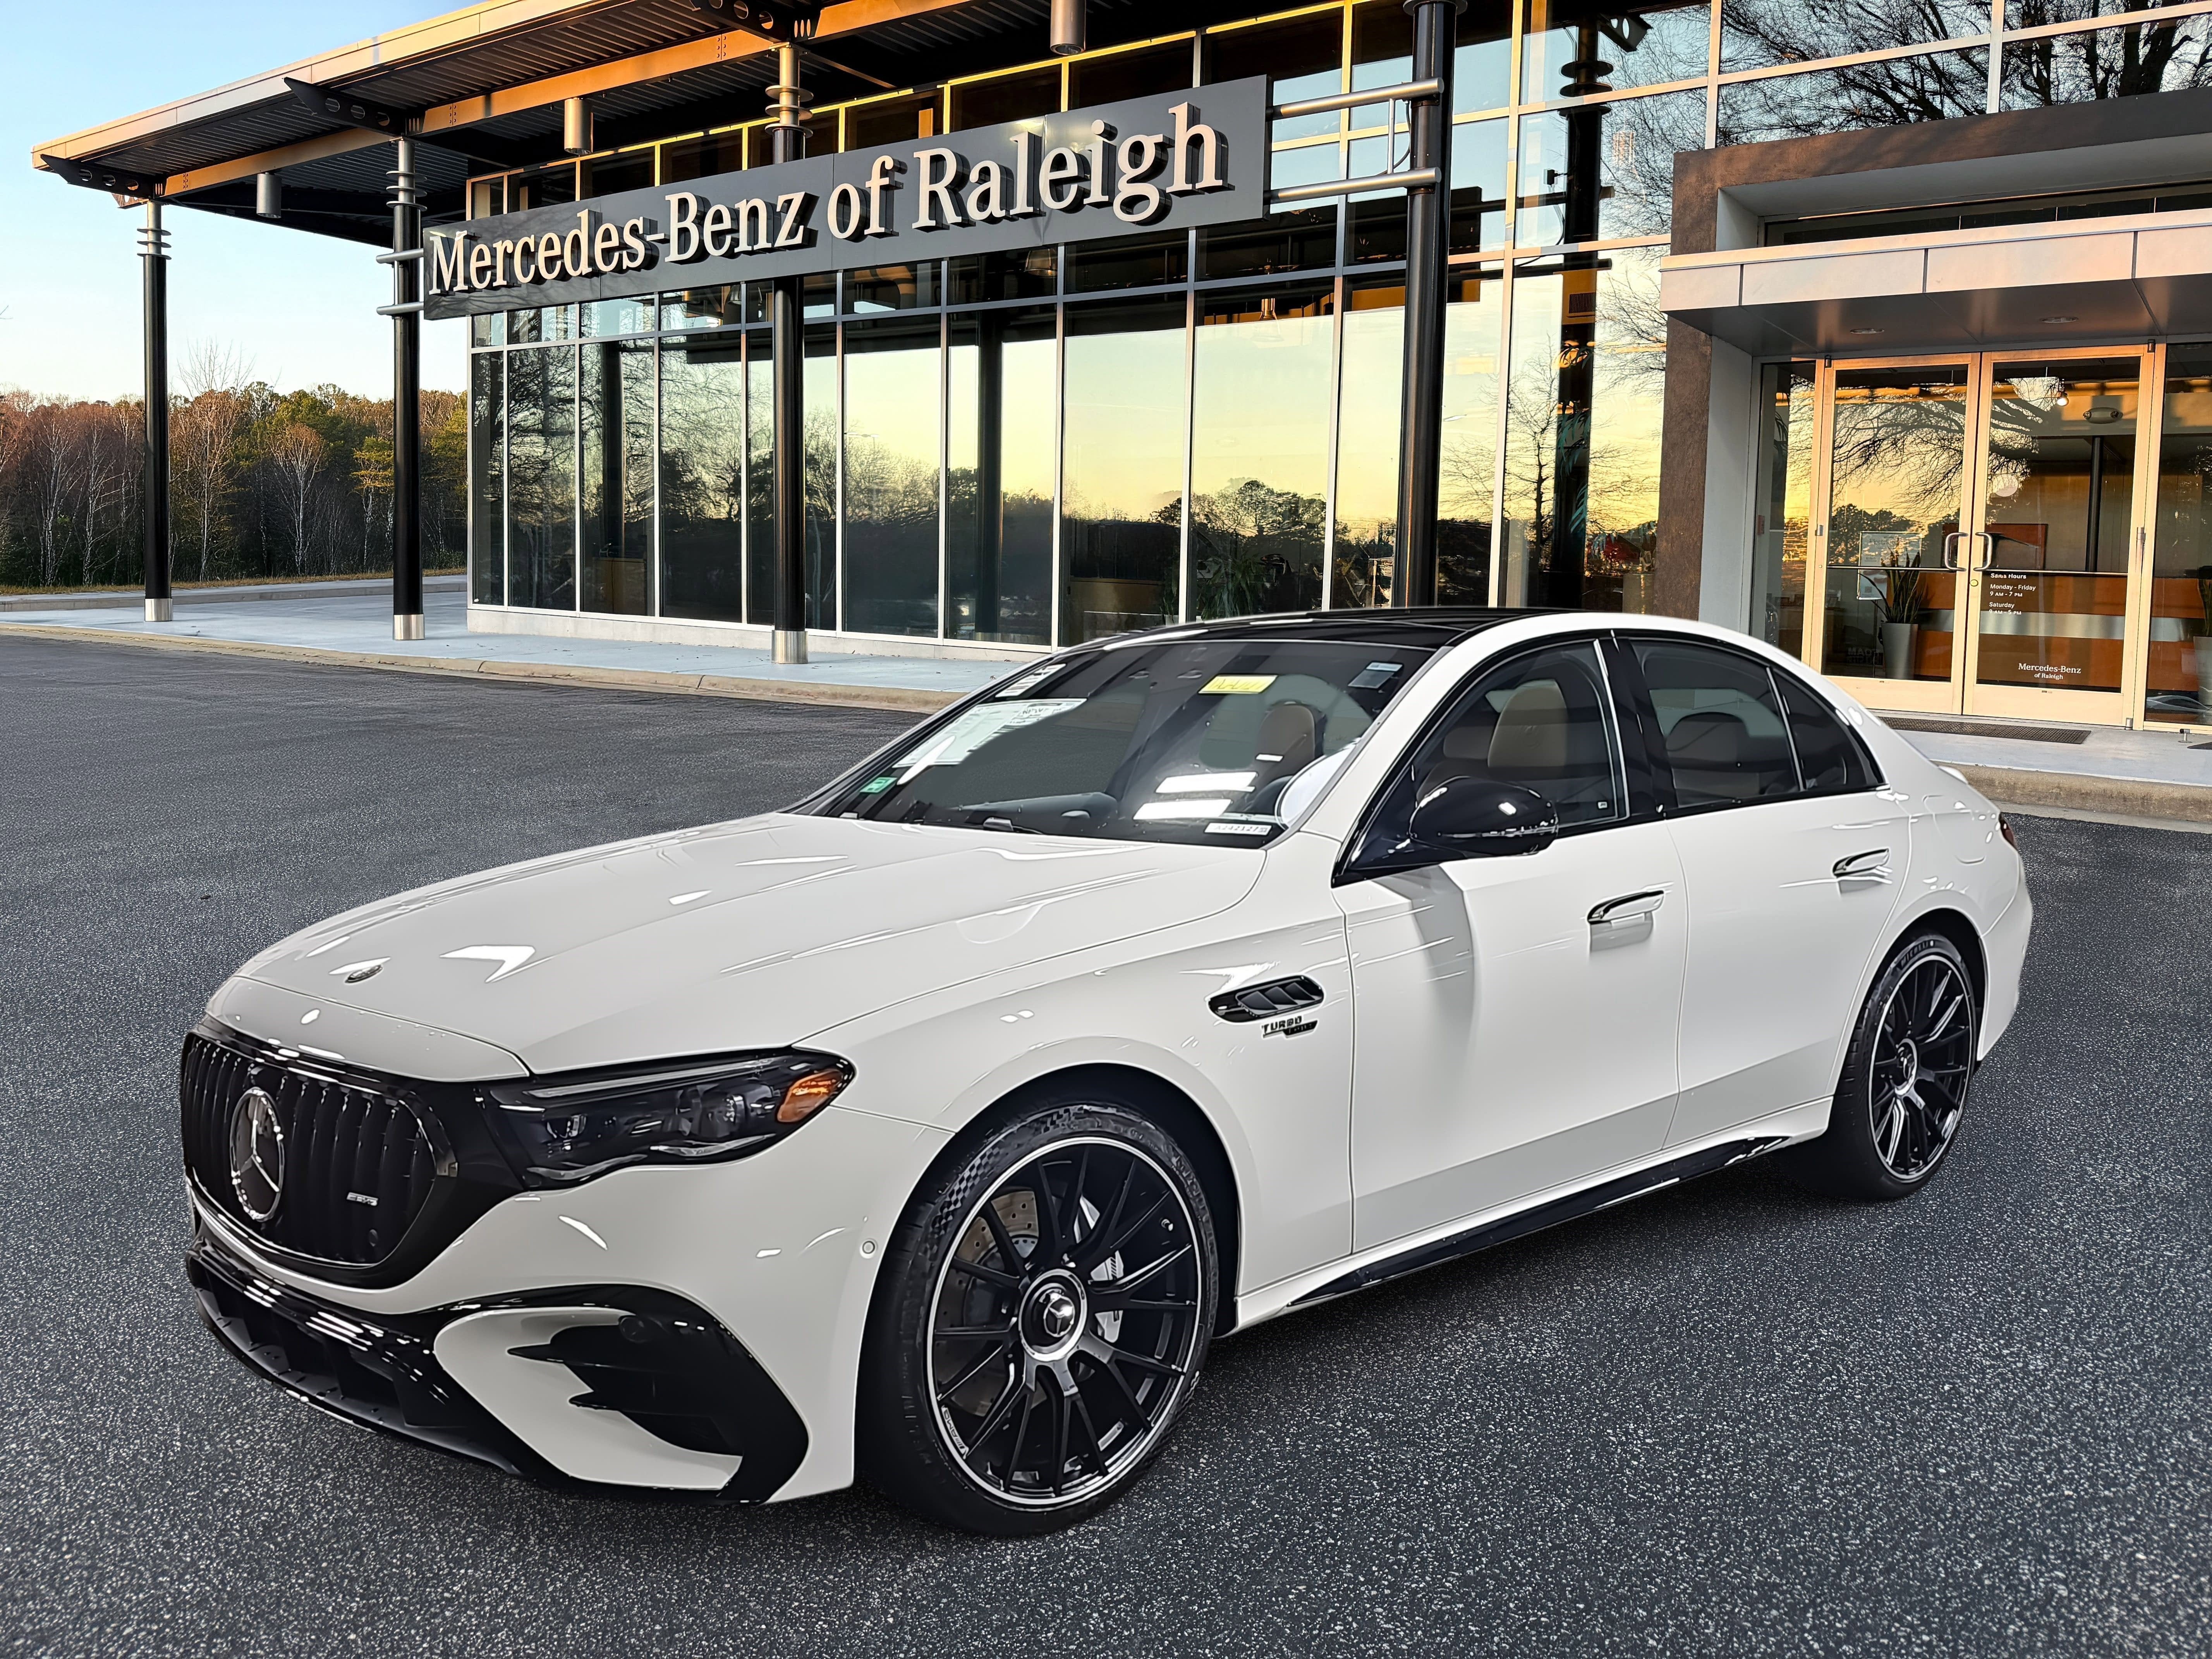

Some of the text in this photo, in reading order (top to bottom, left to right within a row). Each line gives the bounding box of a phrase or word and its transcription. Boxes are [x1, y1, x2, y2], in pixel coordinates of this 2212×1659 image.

[429, 101, 1223, 295] Mercedes-Benz of Raleigh
[2018, 663, 2081, 674] Mercedes-Benz
[1261, 1015, 1302, 1033] TURBO
